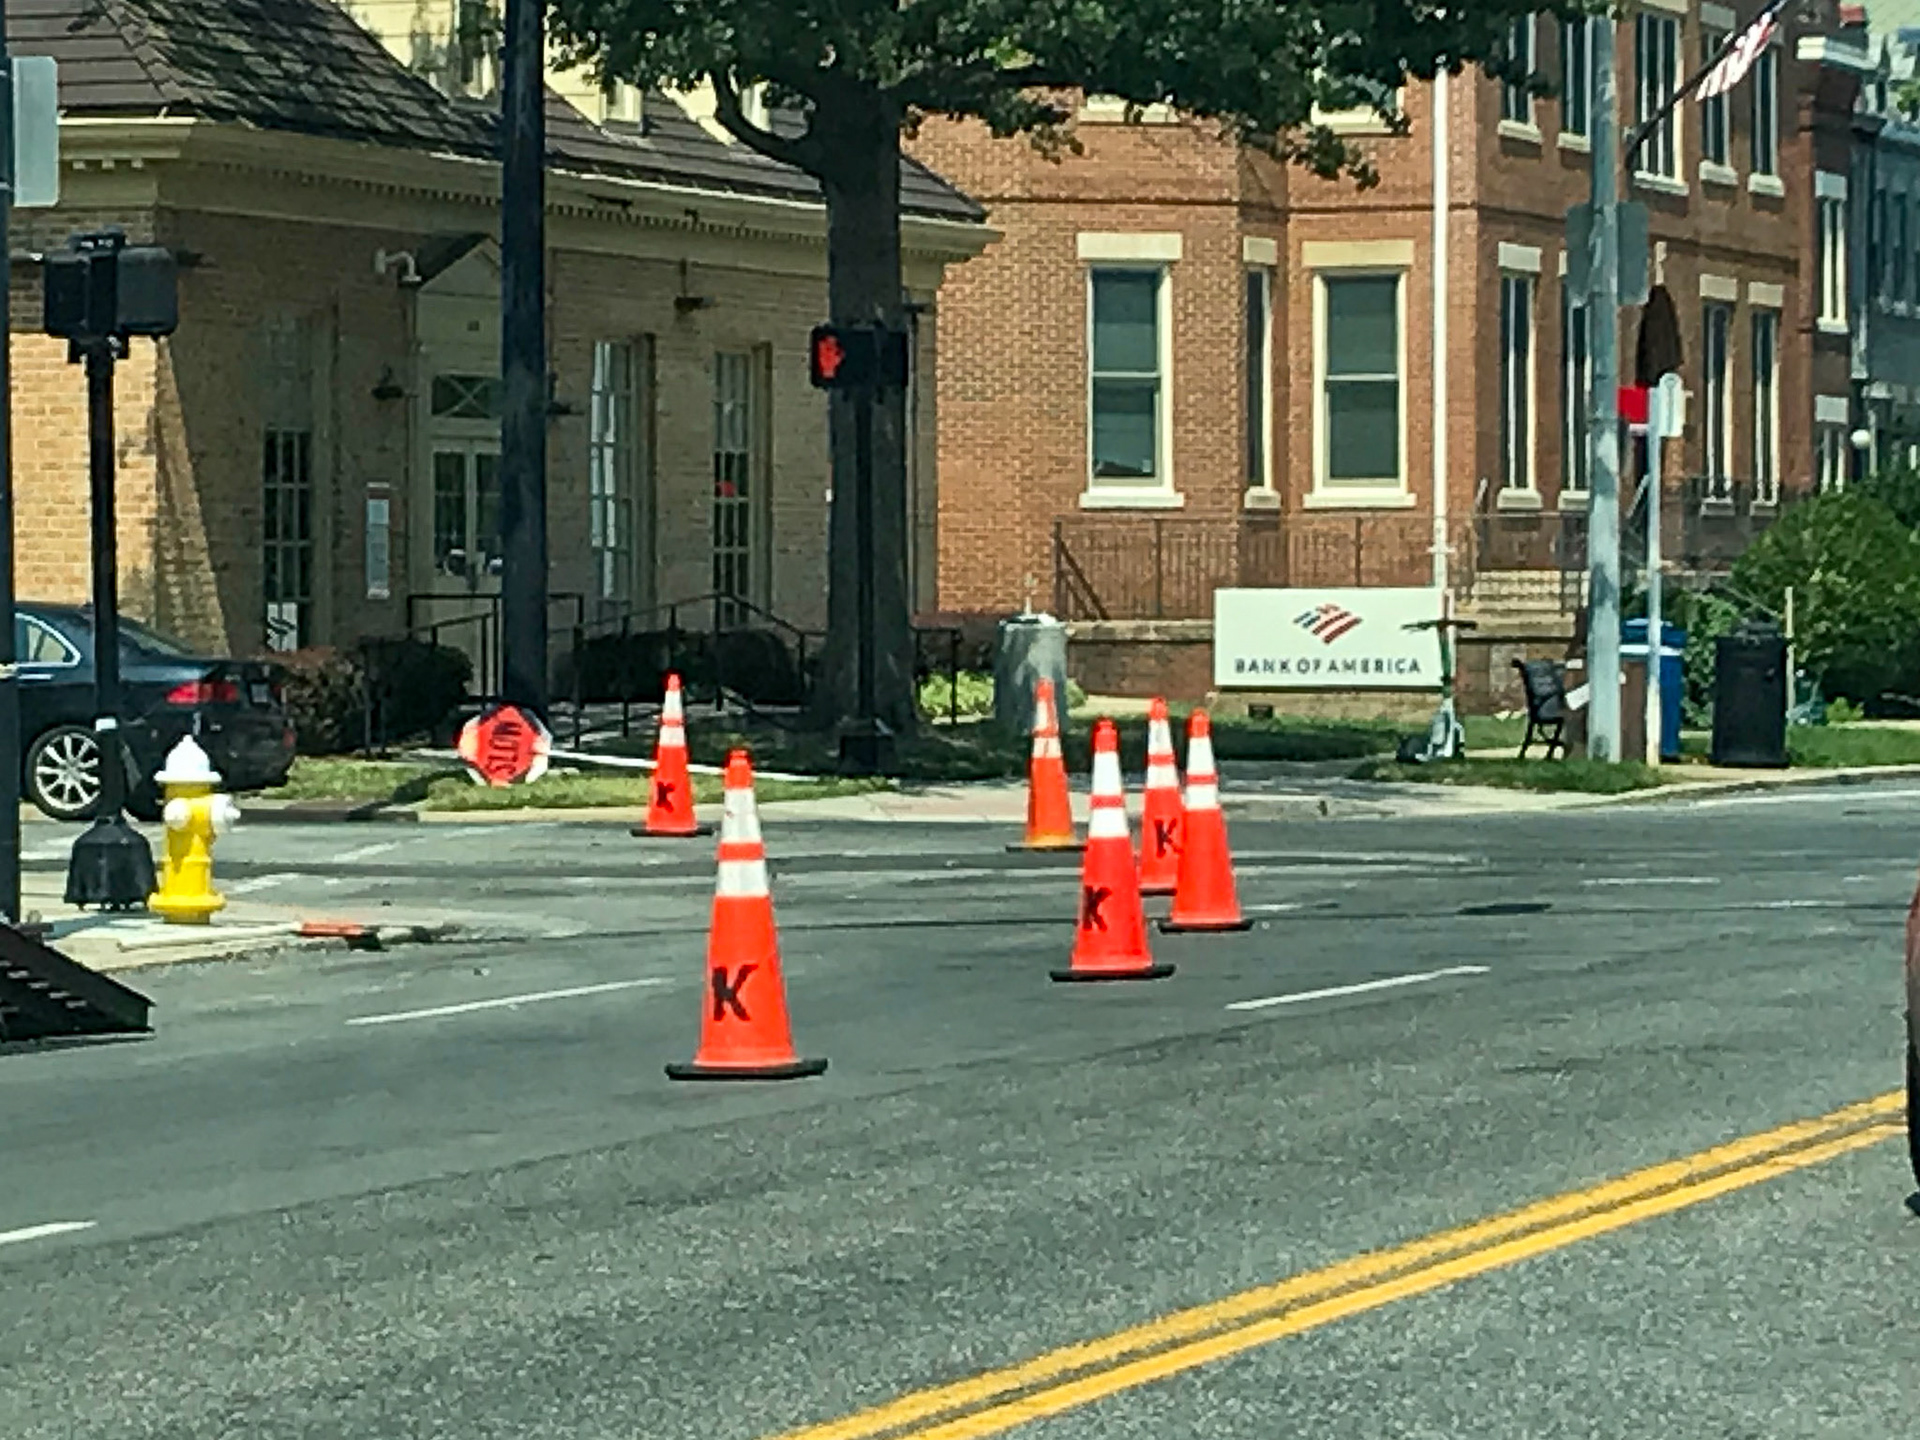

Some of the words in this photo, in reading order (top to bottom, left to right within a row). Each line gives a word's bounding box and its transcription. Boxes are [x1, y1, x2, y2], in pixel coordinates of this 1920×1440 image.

[1235, 658, 1291, 674] BANK
[1297, 657, 1321, 674] OF
[1327, 657, 1421, 674] AMERICA
[1155, 818, 1184, 858] K
[1083, 886, 1113, 931] K
[712, 964, 759, 1021] K
